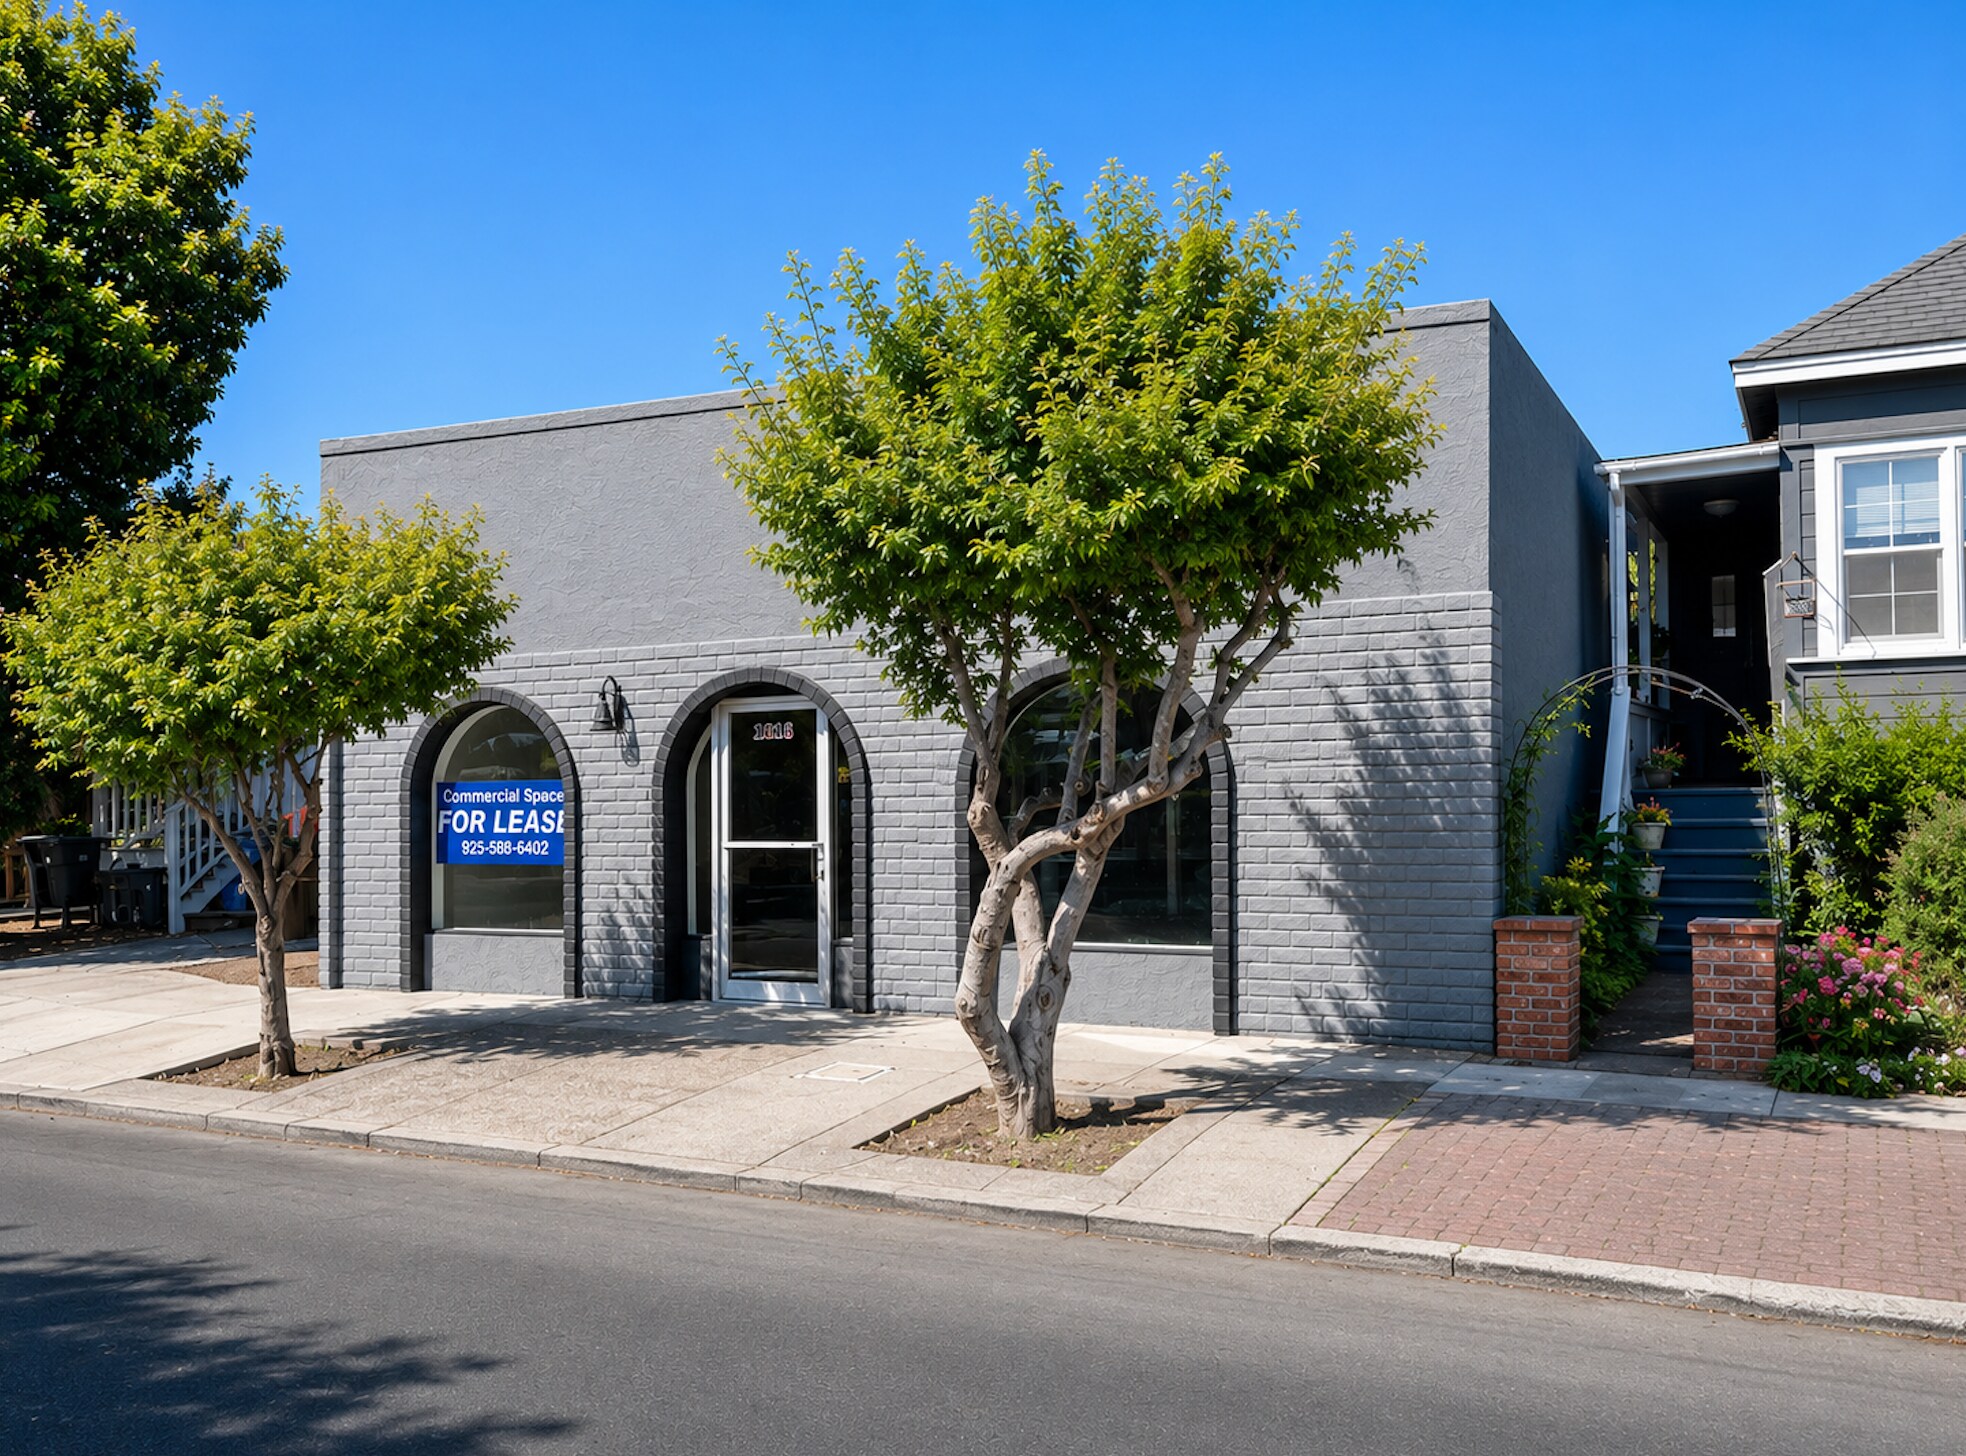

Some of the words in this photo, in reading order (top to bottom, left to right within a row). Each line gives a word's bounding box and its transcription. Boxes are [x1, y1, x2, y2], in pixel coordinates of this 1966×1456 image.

[443, 788, 520, 804] Commercial
[524, 788, 564, 806] Space
[438, 809, 486, 834] FOR
[461, 840, 549, 856] 925-588-6402
